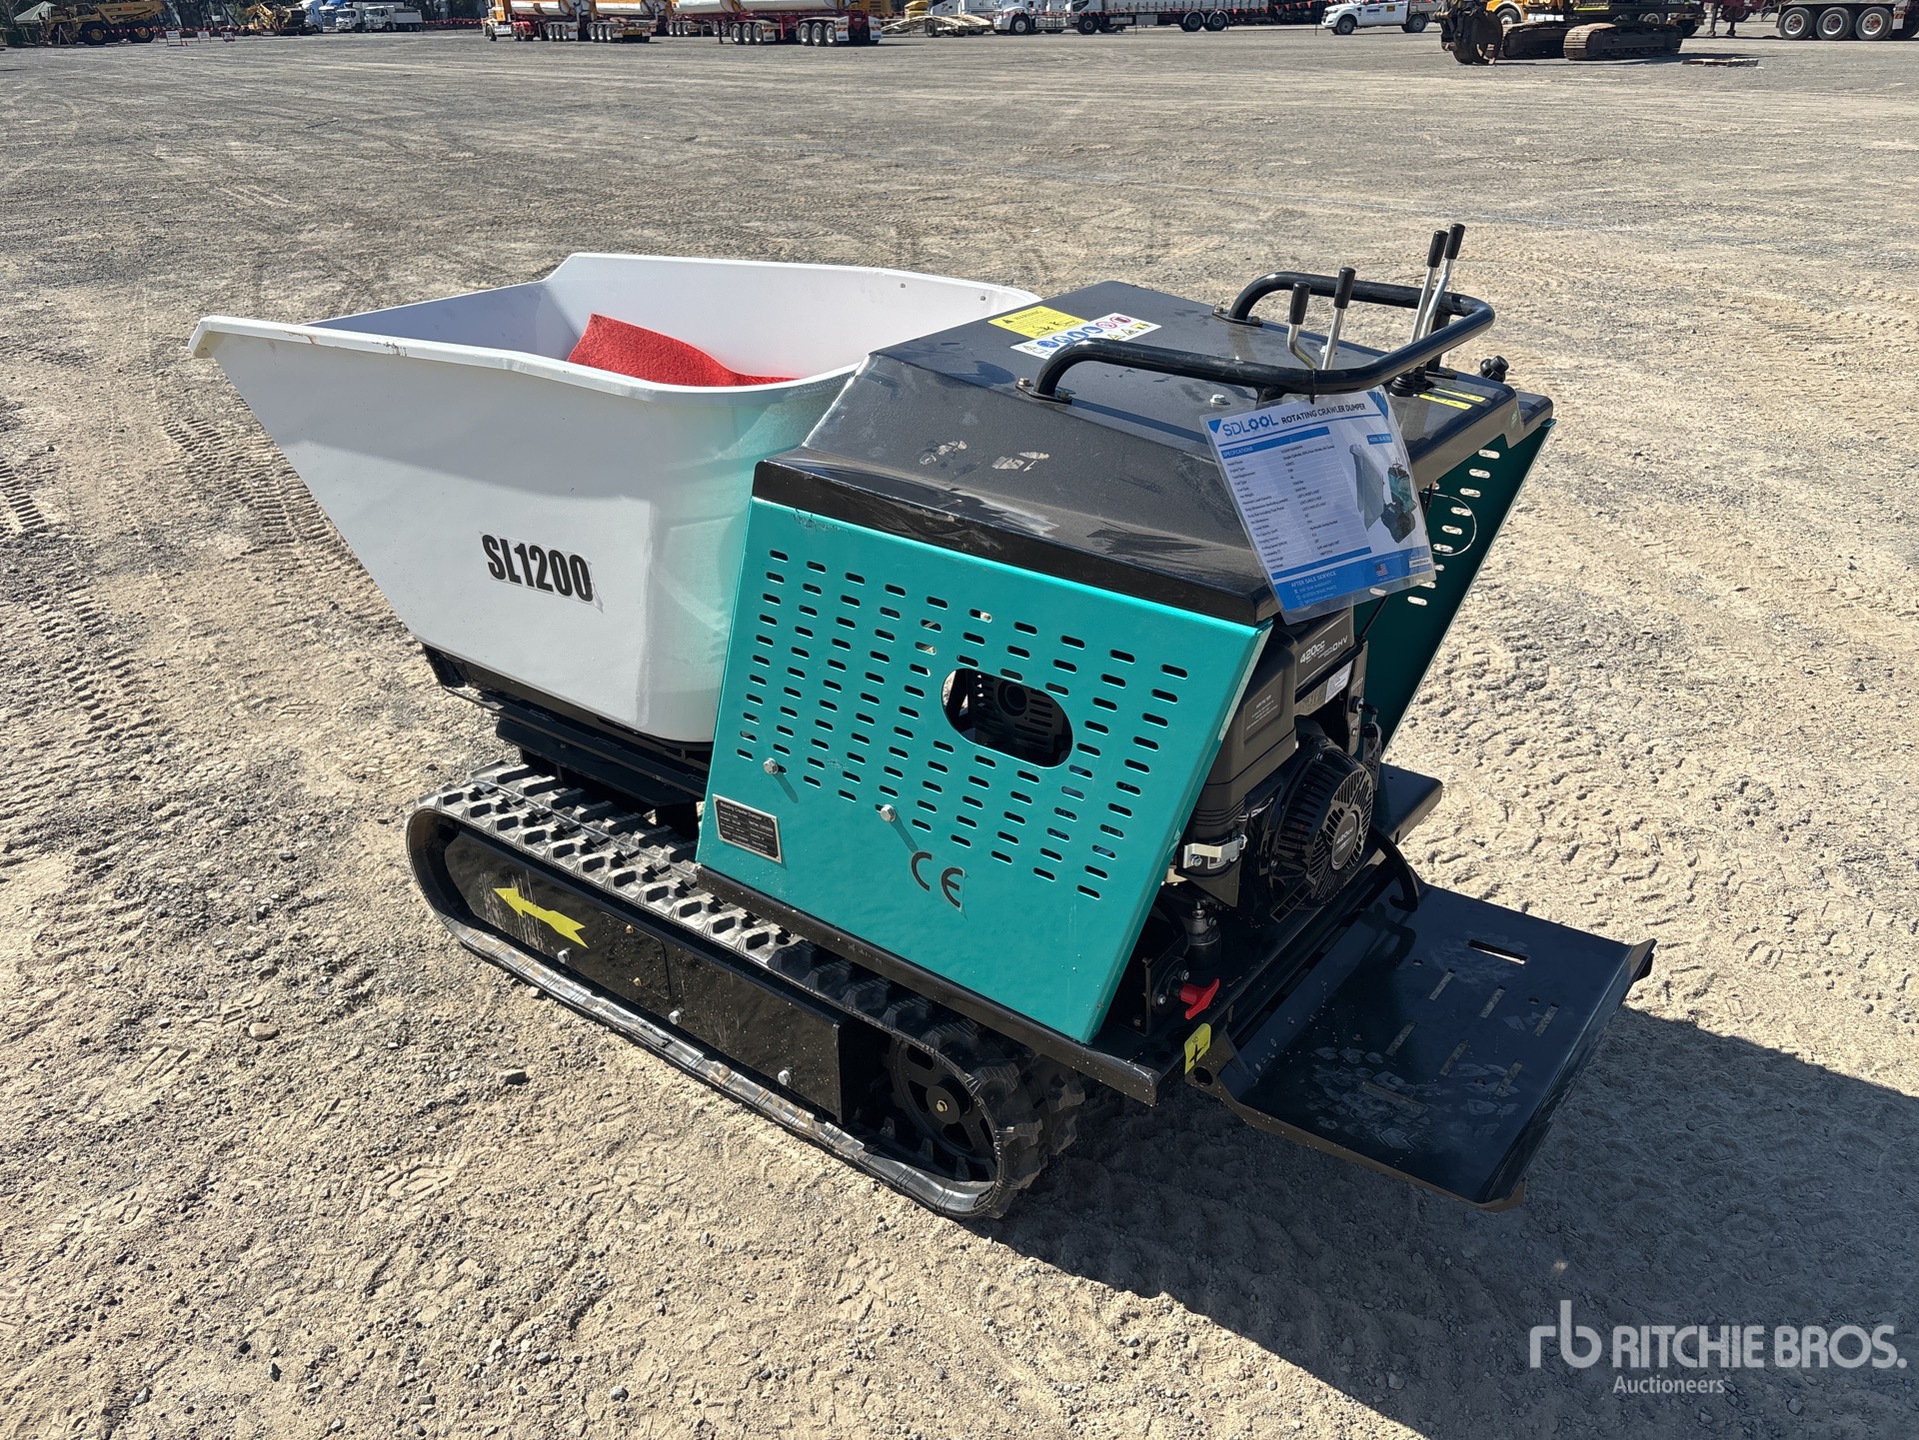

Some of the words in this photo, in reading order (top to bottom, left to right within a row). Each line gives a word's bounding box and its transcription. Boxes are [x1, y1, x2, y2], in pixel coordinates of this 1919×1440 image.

[1222, 414, 1279, 437] SDLOOL
[1281, 409, 1318, 425] ROTATING
[1317, 405, 1345, 418] CRAWLER
[1344, 402, 1366, 413] DUMPER
[482, 534, 594, 602] SL1200
[1299, 640, 1326, 664] 420cc
[1332, 634, 1348, 651] OHV
